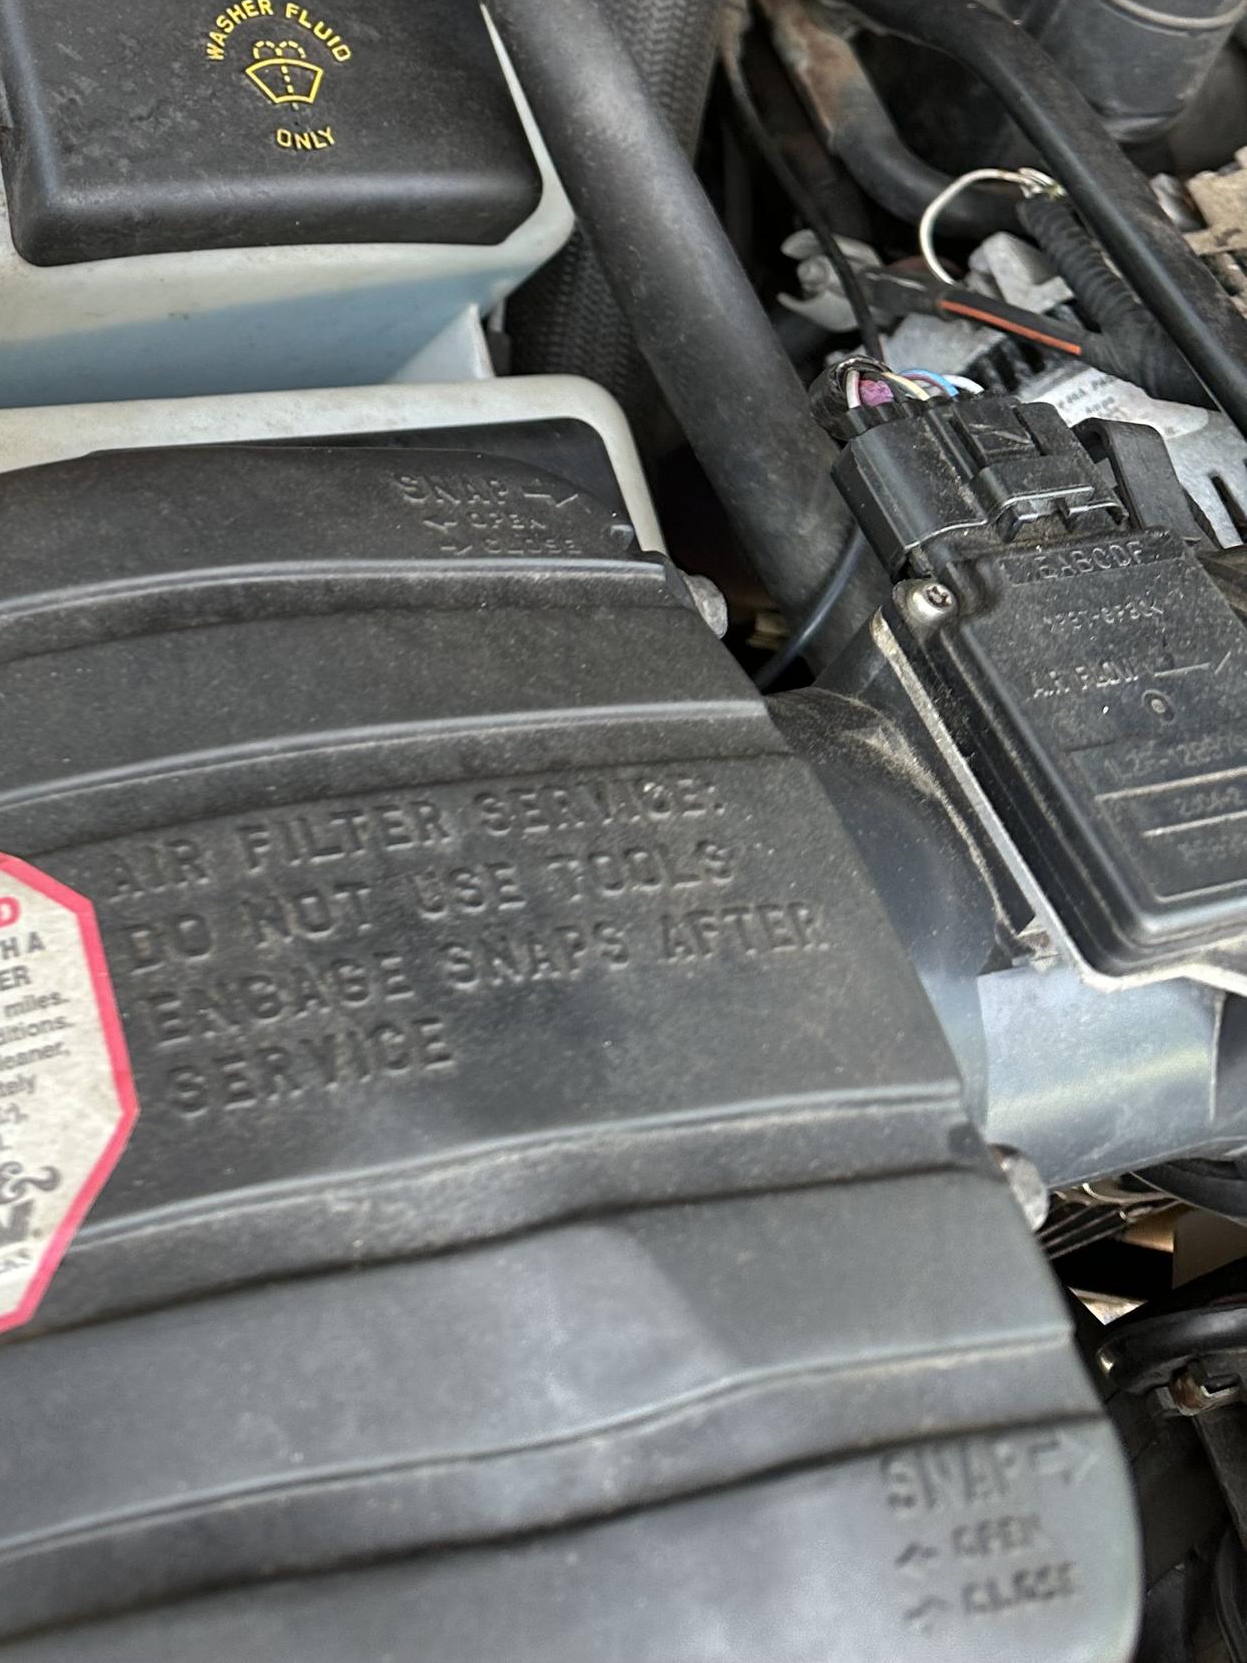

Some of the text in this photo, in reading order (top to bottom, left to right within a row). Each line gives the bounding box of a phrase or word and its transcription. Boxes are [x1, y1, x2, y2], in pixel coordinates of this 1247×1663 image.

[285, 2, 352, 63] FLUID
[276, 126, 336, 150] ONLY
[107, 838, 211, 904] AIR
[238, 800, 454, 876] FILTER
[26, 931, 46, 955] A
[119, 840, 734, 974] DO NOT USE TOOLS
[148, 900, 833, 1048] ENGAGE SNAPS AFTER
[167, 1016, 457, 1118] SERVICE
